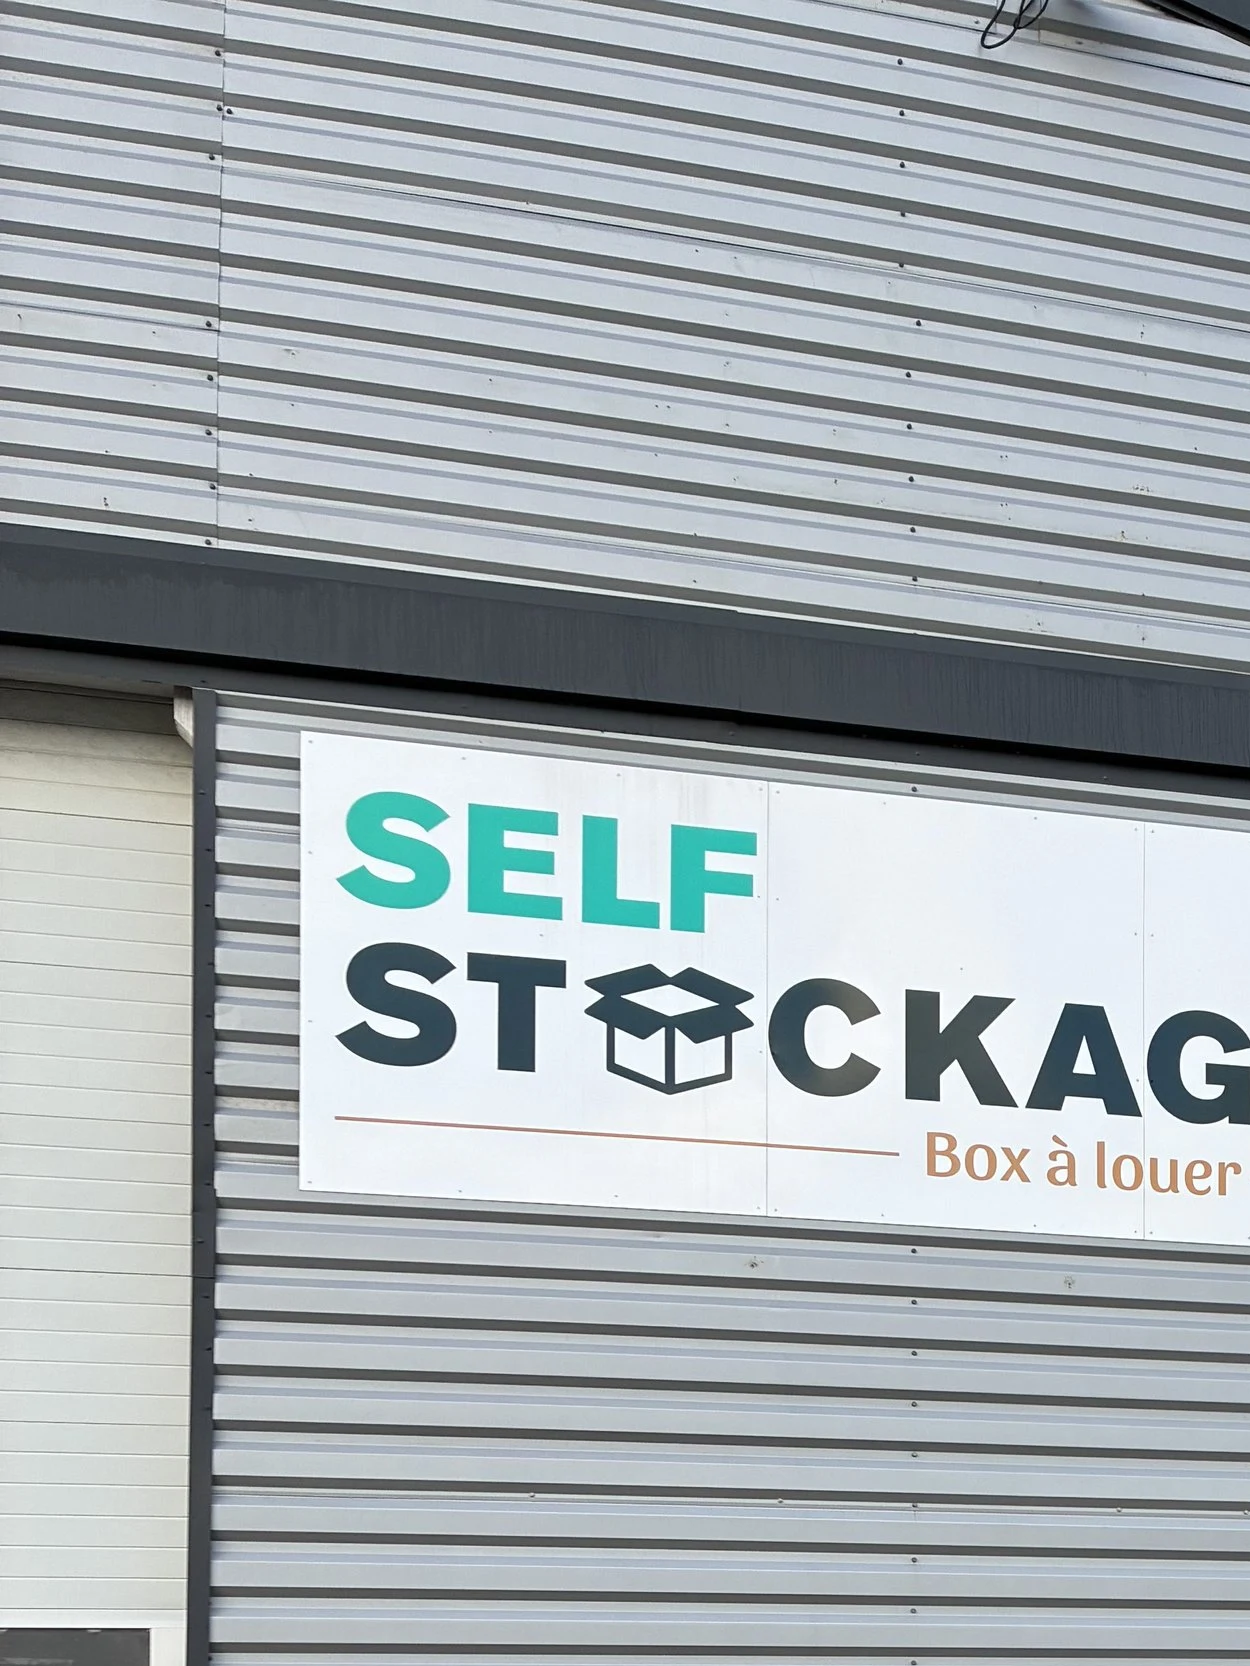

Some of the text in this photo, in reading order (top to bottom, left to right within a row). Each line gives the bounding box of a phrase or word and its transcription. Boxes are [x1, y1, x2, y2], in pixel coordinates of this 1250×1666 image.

[336, 791, 758, 934] SELF
[926, 1132, 1242, 1197] Box à louer
